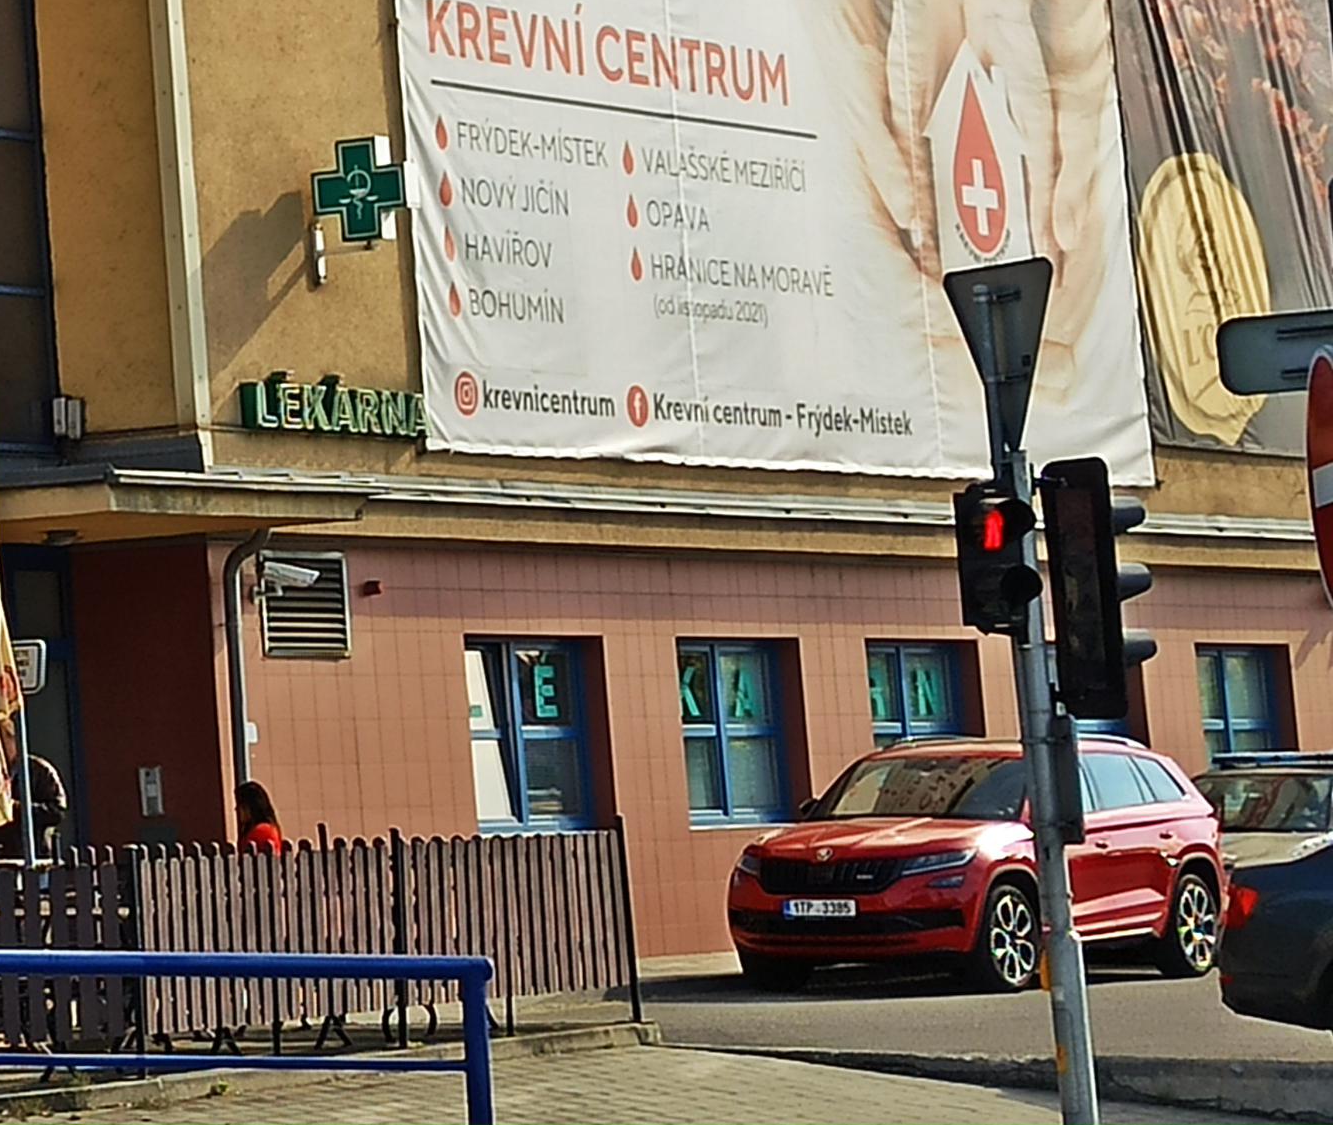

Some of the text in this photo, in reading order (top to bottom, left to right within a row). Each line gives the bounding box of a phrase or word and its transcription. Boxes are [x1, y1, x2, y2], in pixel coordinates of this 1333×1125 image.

[595, 24, 790, 106] CENTRUM
[457, 117, 608, 168] FRÝDEK-MÍSTEK
[641, 145, 806, 192] VALAŠSKÉ MEZIŘÍČÍ
[461, 175, 569, 216] NOVÝ JIČÍN
[646, 200, 710, 232] OPAVA
[464, 229, 552, 269] HAVÍŘOV
[651, 253, 834, 297] HRANICE NA MORAVĚ
[469, 288, 564, 324] BOHUMÍN
[654, 294, 769, 328] (od listopadu 2021)
[483, 380, 615, 417] krevnicentrum
[653, 392, 709, 423] Krevní
[713, 401, 782, 428] centrum
